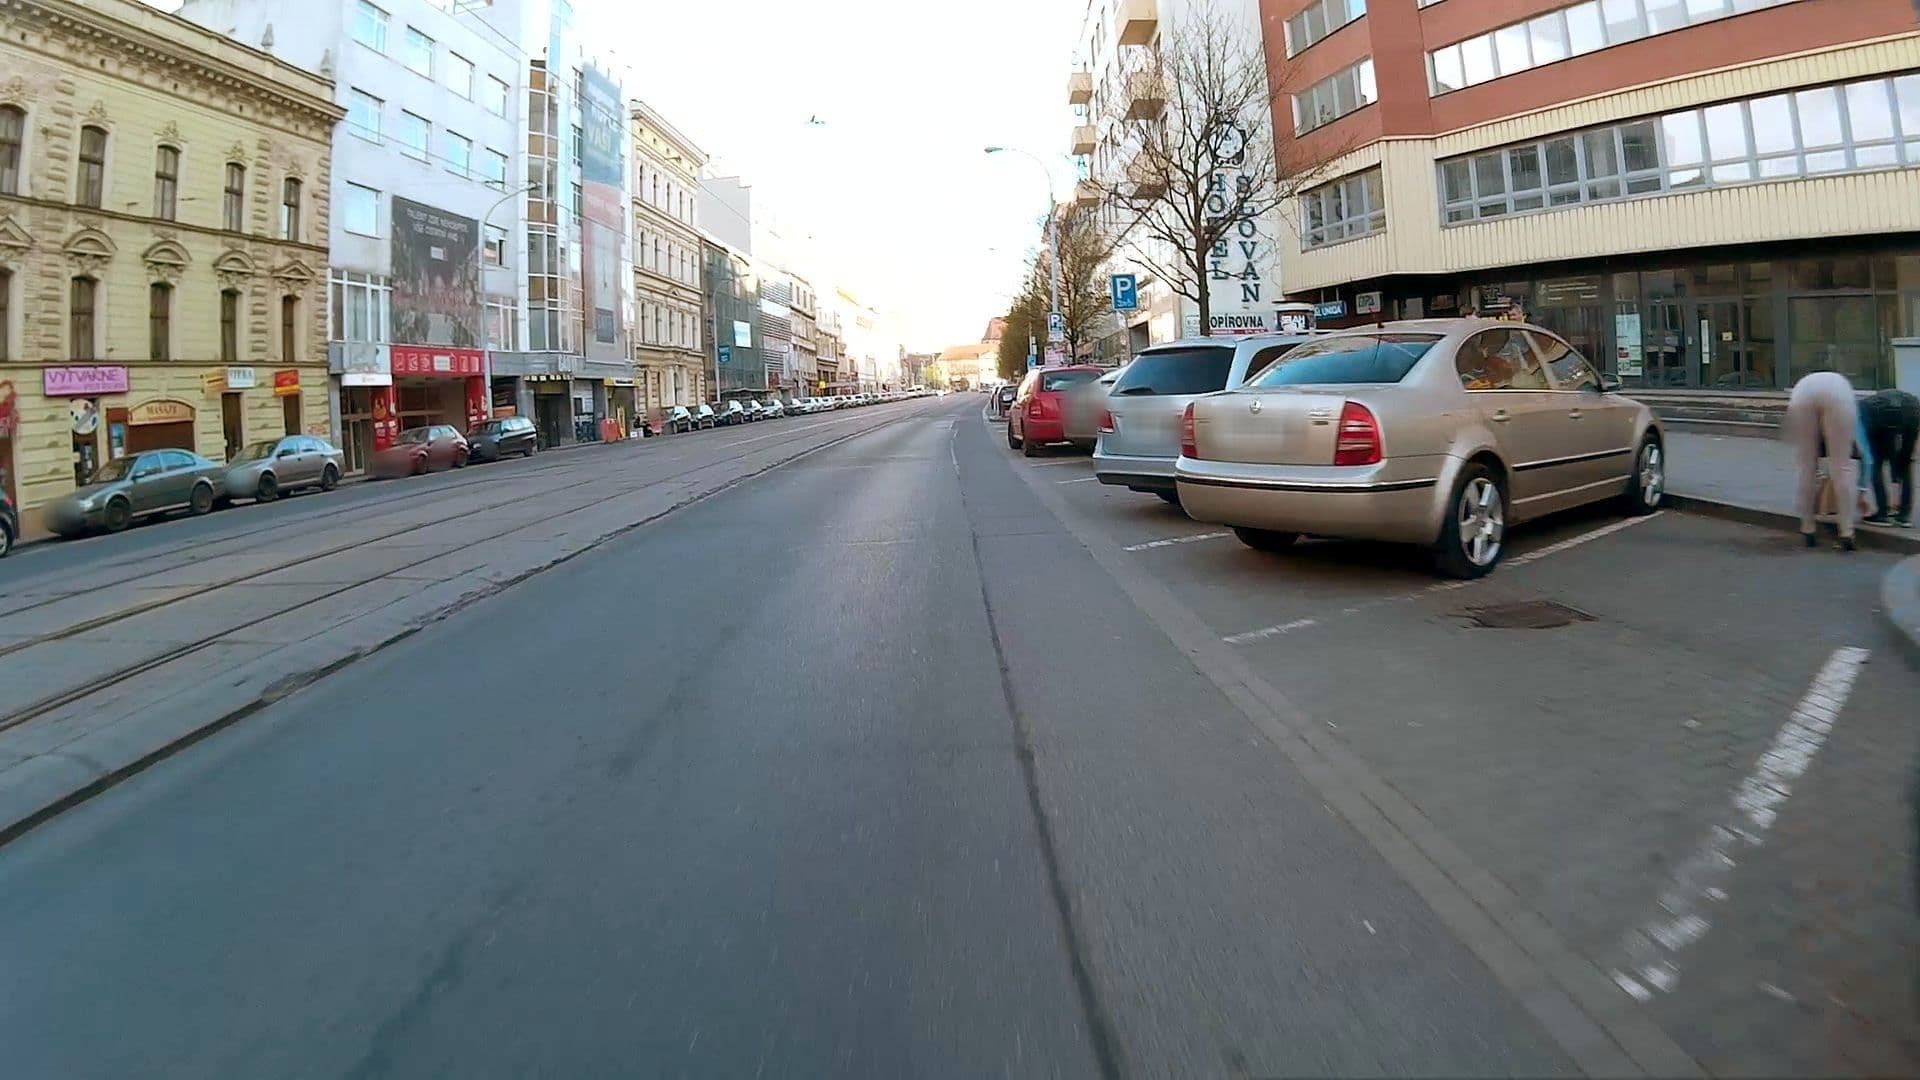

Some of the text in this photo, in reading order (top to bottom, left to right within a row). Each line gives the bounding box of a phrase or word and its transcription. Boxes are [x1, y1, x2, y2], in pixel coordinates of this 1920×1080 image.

[1236, 175, 1261, 303] SLOVAN
[1116, 278, 1132, 299] P
[1208, 313, 1264, 328] OPÍROVNA
